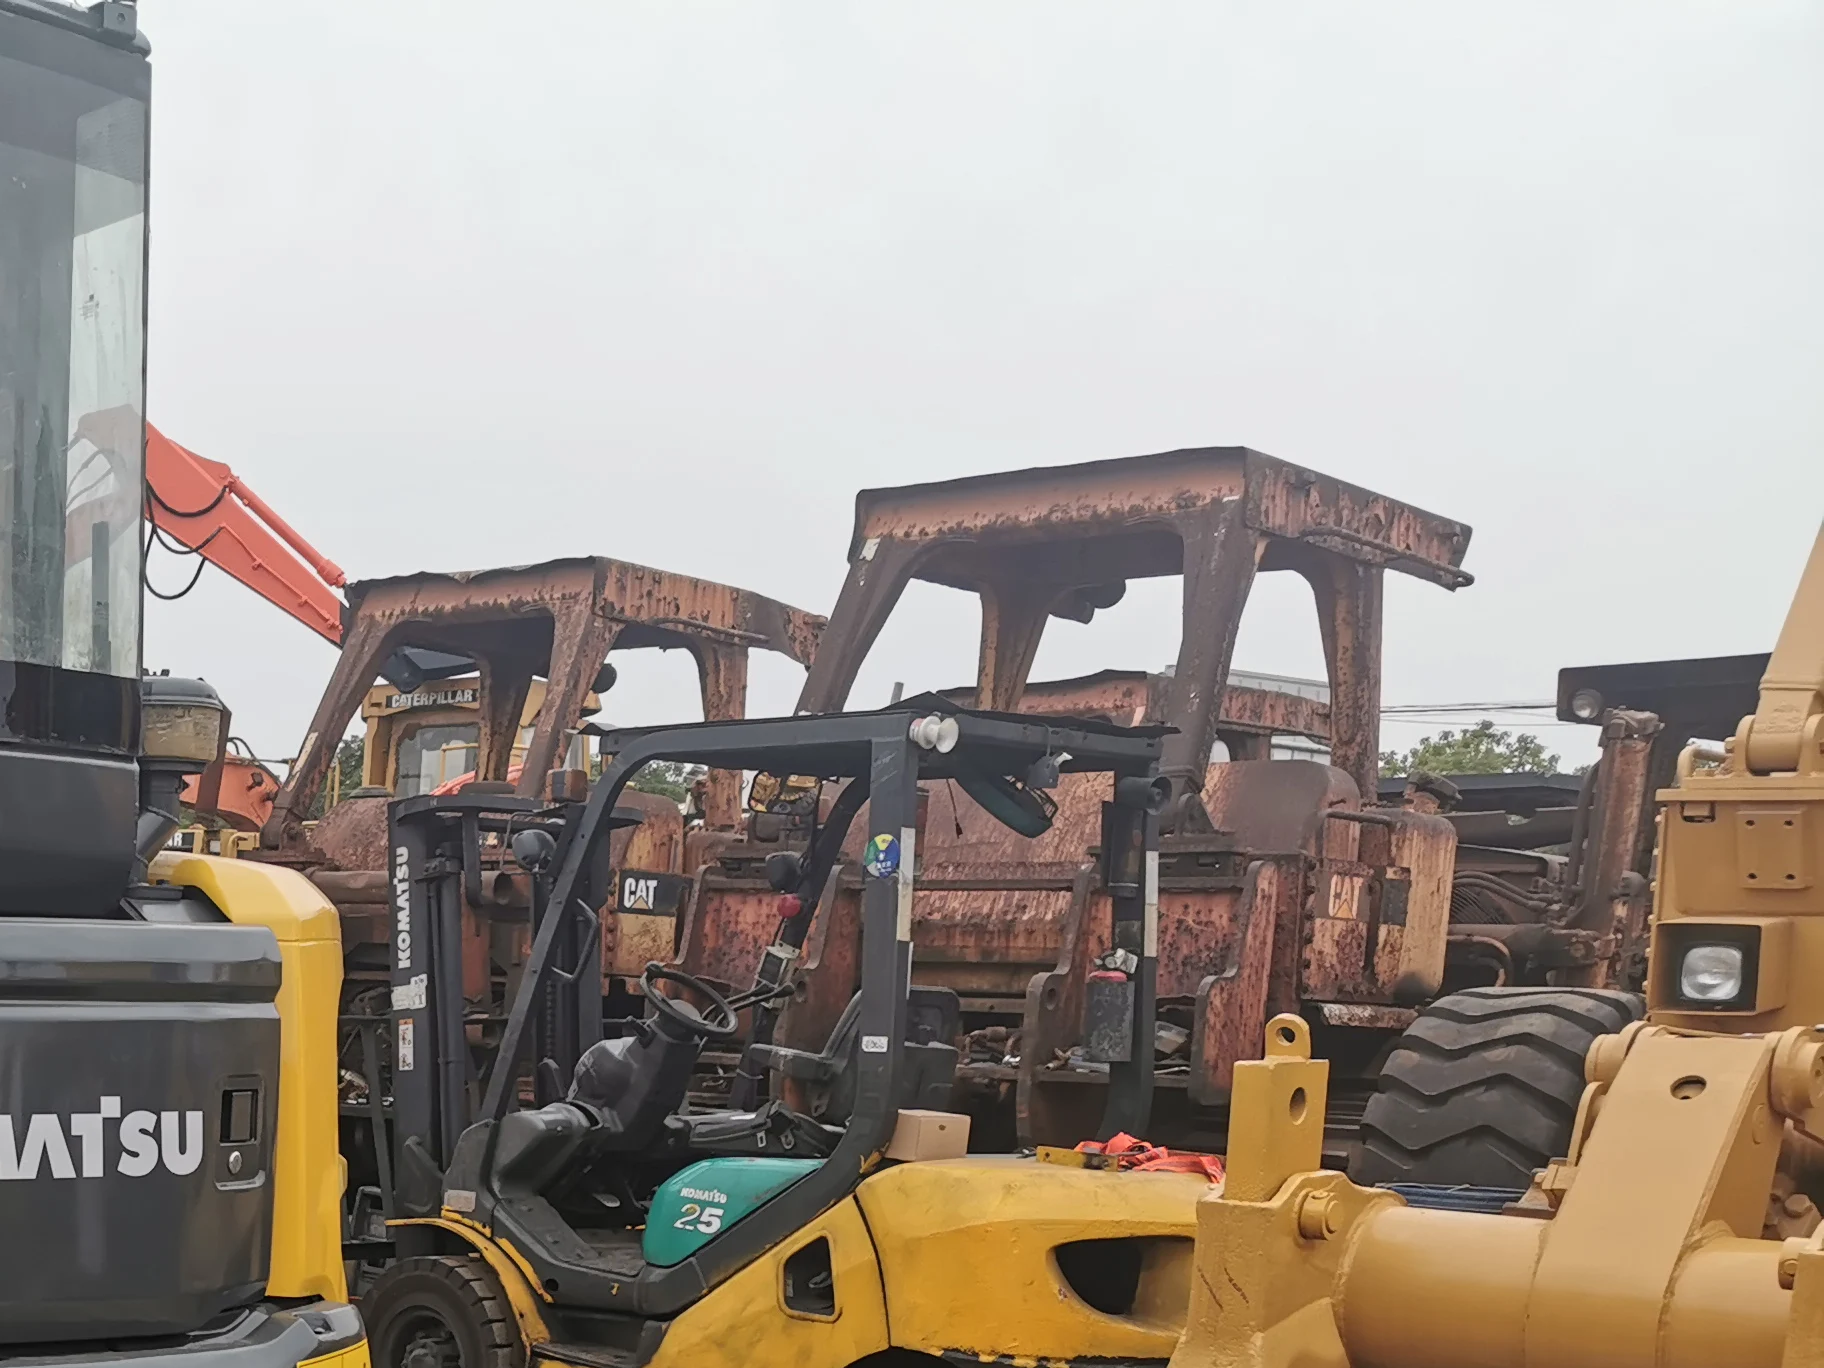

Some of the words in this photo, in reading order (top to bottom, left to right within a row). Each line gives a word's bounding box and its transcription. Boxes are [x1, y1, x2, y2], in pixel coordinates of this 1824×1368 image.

[391, 689, 474, 707] CATERPILLAR
[392, 845, 412, 970] KOMATSU
[623, 877, 658, 910] CAT
[1328, 874, 1364, 920] CAT
[679, 1187, 728, 1204] KOMATSU
[673, 1203, 725, 1234] 25
